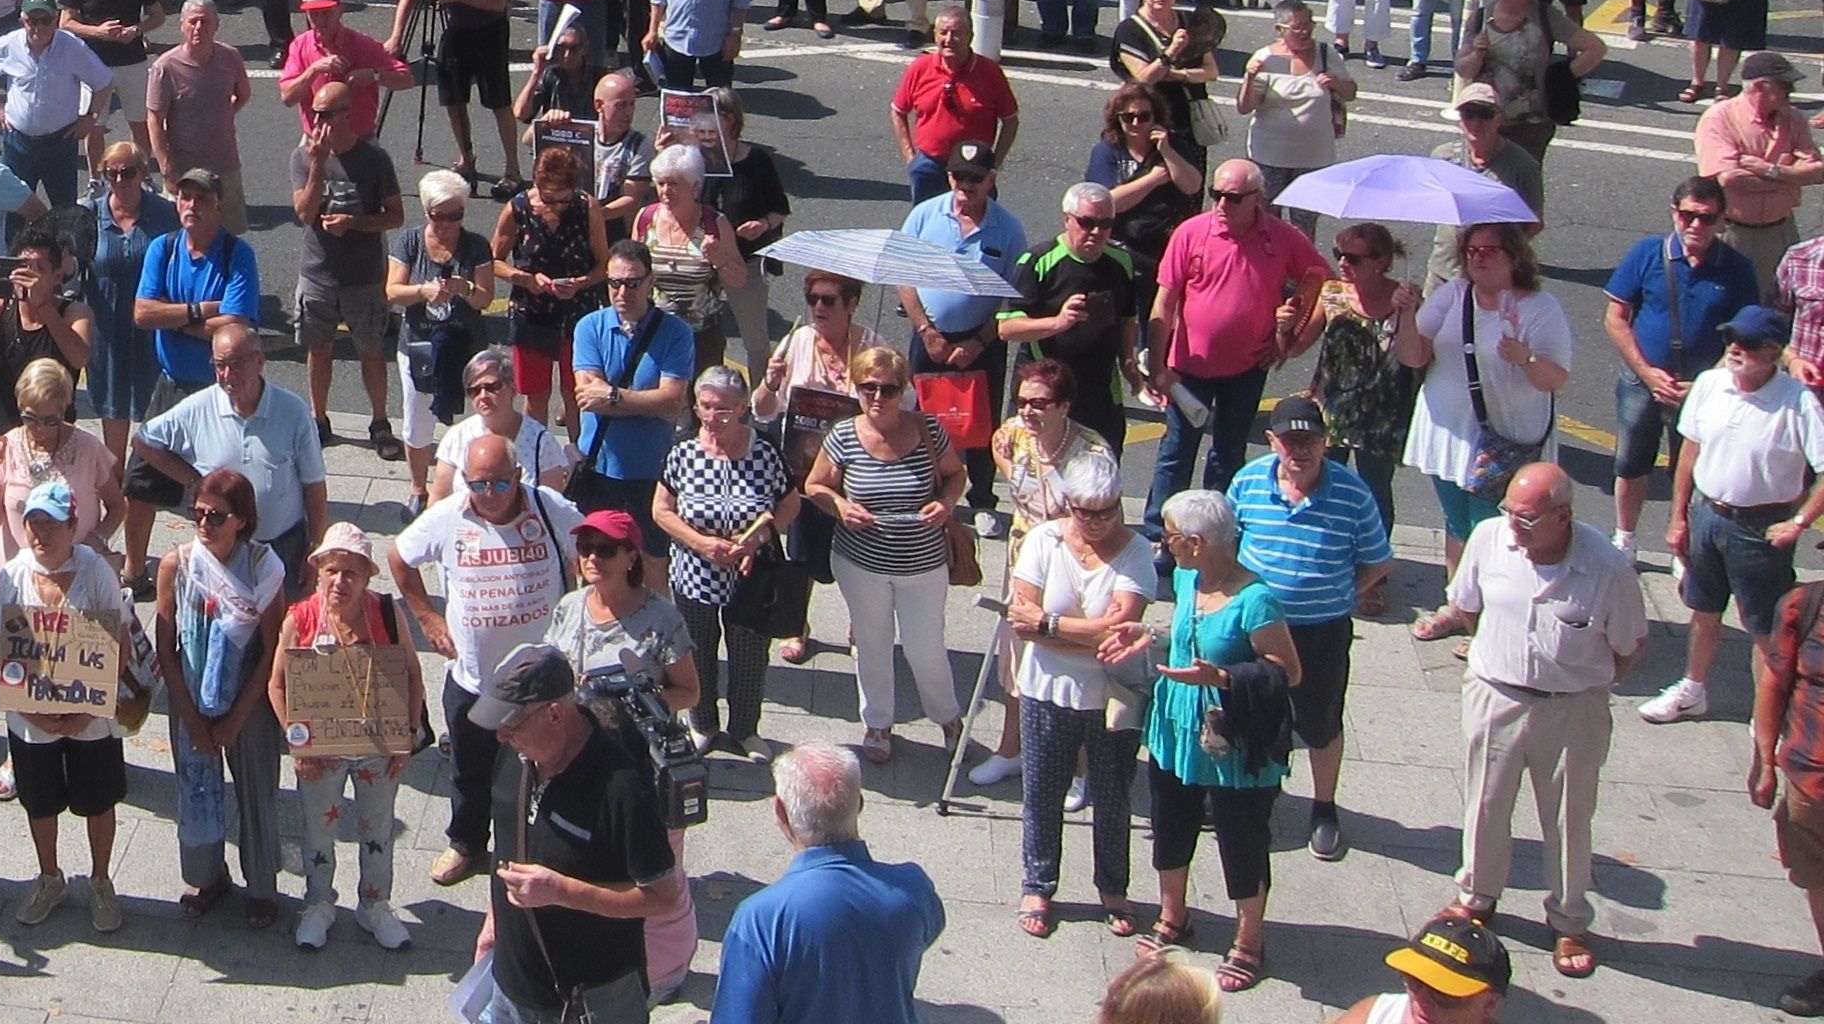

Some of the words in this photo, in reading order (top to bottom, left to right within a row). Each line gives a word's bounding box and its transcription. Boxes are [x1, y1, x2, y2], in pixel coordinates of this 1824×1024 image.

[460, 545, 546, 566] ASJUBI40
[460, 589, 476, 598] SIN
[480, 580, 550, 598] PENALIZAR
[461, 605, 549, 628] COTIZADOS
[79, 649, 105, 670] LAS
